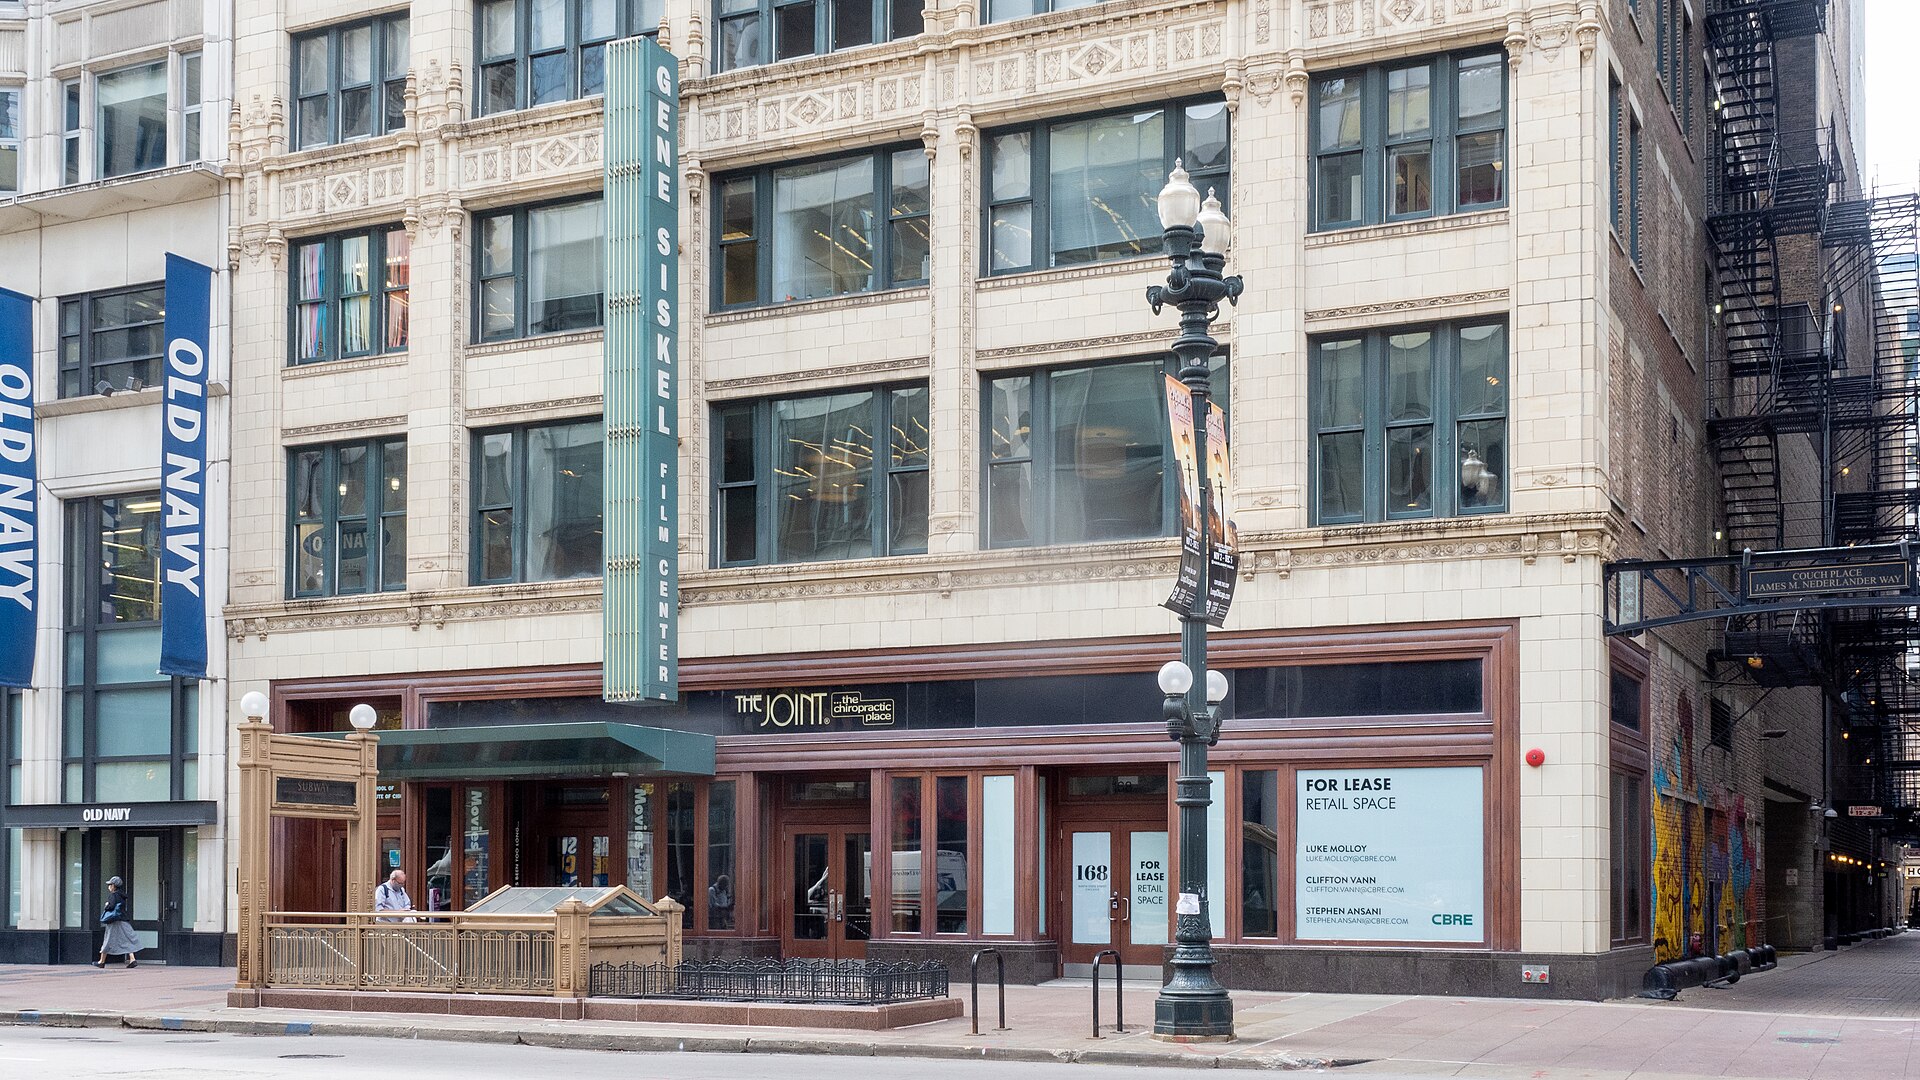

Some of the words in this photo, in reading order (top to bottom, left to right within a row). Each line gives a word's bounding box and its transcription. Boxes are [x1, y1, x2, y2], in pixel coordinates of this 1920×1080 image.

[656, 65, 672, 203] GENE
[656, 227, 671, 435] SISKEL
[168, 337, 204, 444] OLD
[0, 363, 33, 463] OLD
[660, 462, 669, 543] FILM
[166, 451, 201, 598] NAVY
[0, 473, 34, 612] NAVY
[1792, 571, 1828, 581] COUCH
[1830, 568, 1862, 578] PLACE
[1754, 582, 1787, 592] JAMES
[1788, 581, 1800, 590] M.
[1802, 576, 1877, 589] NEDERLANDER
[1879, 574, 1902, 584] WAY
[659, 559, 669, 683] CENTER
[735, 695, 762, 713] THE
[760, 692, 828, 727] JOINT
[833, 702, 892, 716] chiropractic
[865, 711, 892, 722] place
[297, 781, 330, 793] SUBWAY
[1306, 779, 1338, 792] FOR
[1344, 778, 1391, 791] LEASE
[1306, 798, 1348, 810] RETAIL
[1353, 797, 1396, 810] SPACE
[83, 808, 104, 822] OLD
[104, 807, 131, 821] NAVY
[470, 790, 483, 851] Movies
[634, 788, 648, 850] Movies
[1306, 845, 1328, 853] LUKE
[1330, 845, 1367, 853] MOLLOY
[1140, 861, 1160, 870] FOR
[1306, 855, 1397, 864] LUKE.MOLLOY@CBRE.COM
[1076, 864, 1108, 881] 168
[1136, 872, 1165, 881] LEASE
[1306, 876, 1349, 884] CLIFFTON
[1350, 876, 1376, 884] VANN
[1137, 884, 1164, 893] RETAIL
[1137, 896, 1163, 905] SPACE
[1306, 907, 1346, 915] STEPHEN
[1347, 907, 1382, 916] ANSANI
[1306, 917, 1409, 925] STEPHEN.ANSANI@CBRE.COM
[1431, 914, 1473, 926] CBRE
